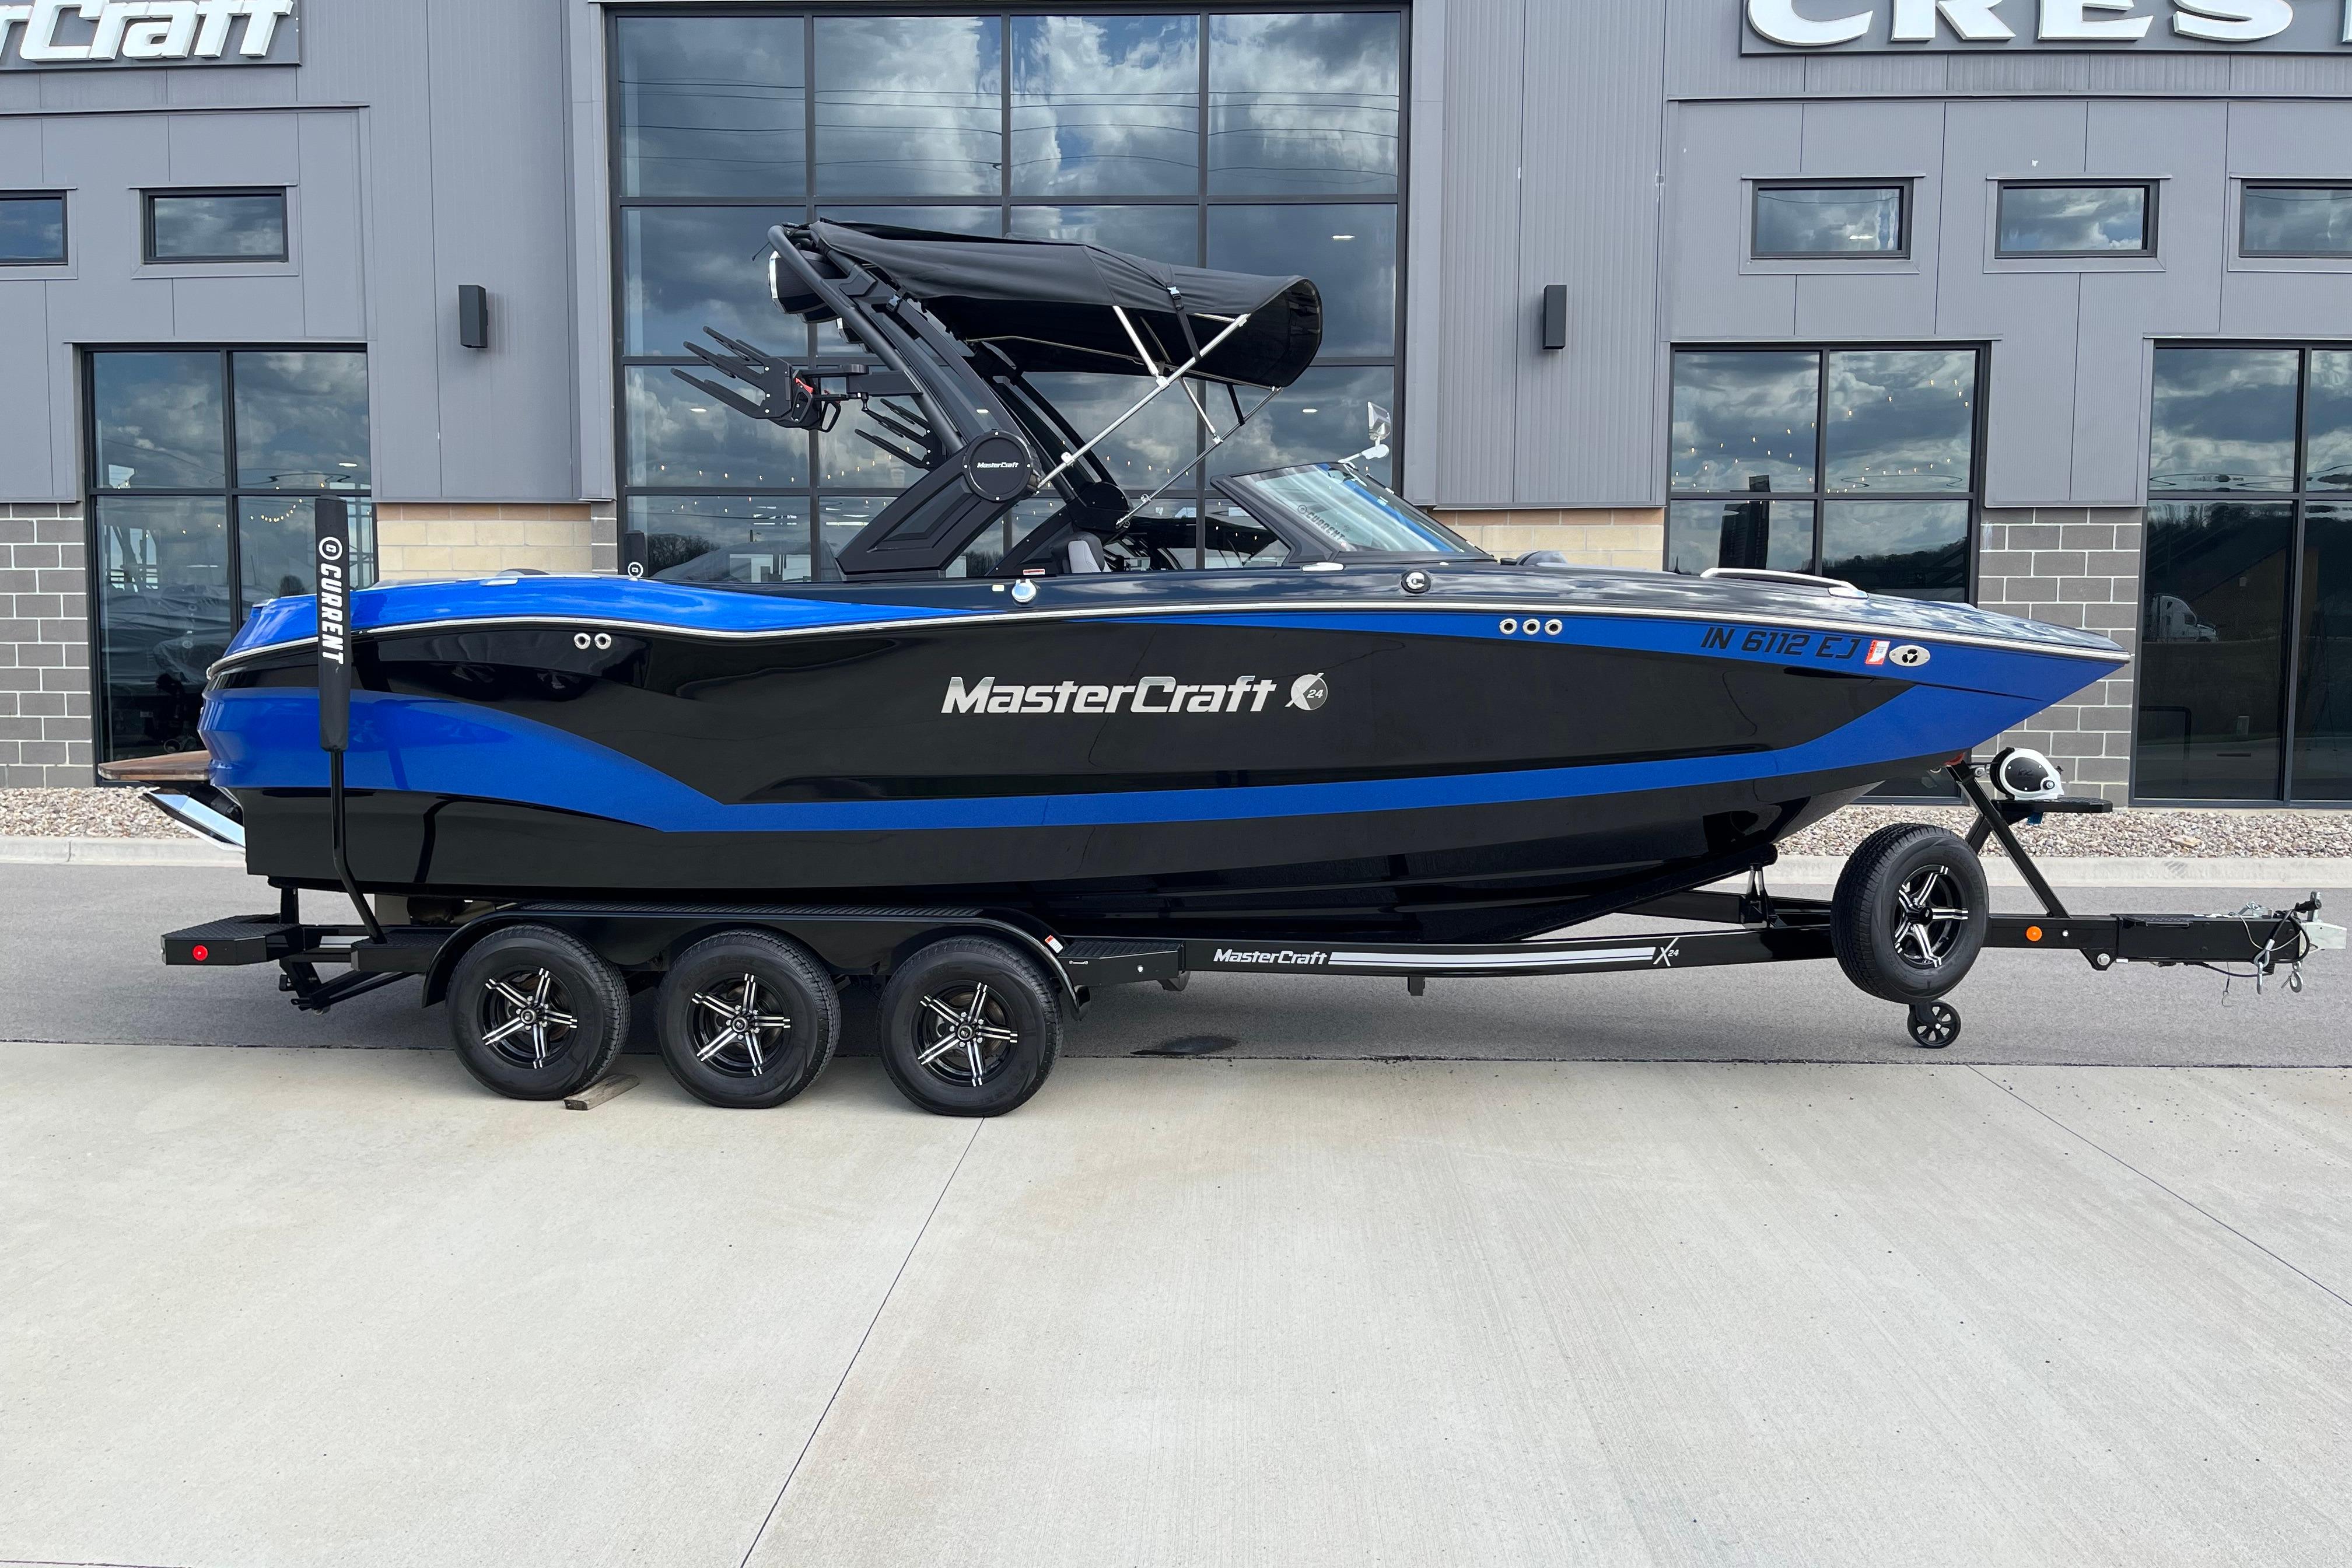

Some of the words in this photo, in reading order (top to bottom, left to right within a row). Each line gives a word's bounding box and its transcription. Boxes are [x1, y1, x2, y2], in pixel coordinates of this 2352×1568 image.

[1747, 0, 2352, 46] CRES
[321, 563, 344, 664] CURRENT
[1700, 626, 1735, 649] IN
[1741, 631, 1811, 655] 6112
[1815, 636, 1861, 659] EJ
[941, 676, 1277, 713] MasterCraft
[1213, 949, 1327, 964] MasterCraft
